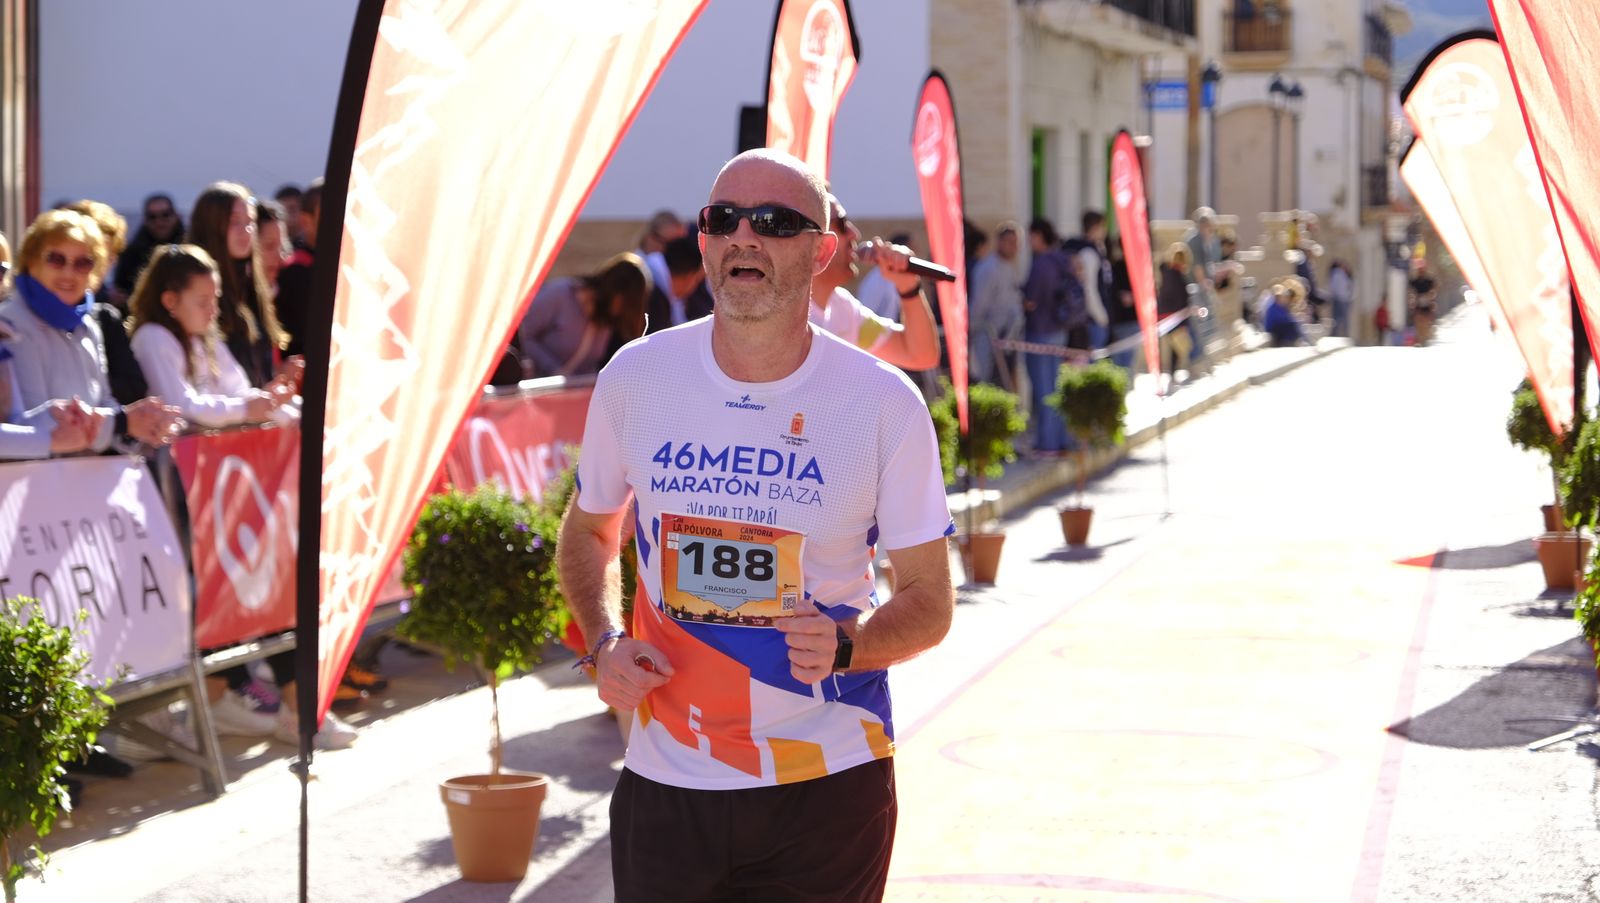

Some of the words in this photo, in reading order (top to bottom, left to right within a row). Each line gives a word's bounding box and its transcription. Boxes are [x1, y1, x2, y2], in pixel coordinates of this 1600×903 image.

[651, 475, 760, 497] MARATÓN
[768, 483, 823, 507] BAZA
[672, 523, 682, 533] LA
[684, 523, 723, 537] PÓLVORA
[740, 527, 773, 538] CANTORIA
[739, 534, 754, 542] 2024
[682, 541, 774, 582] 188
[704, 584, 747, 595] FRANCISCO
